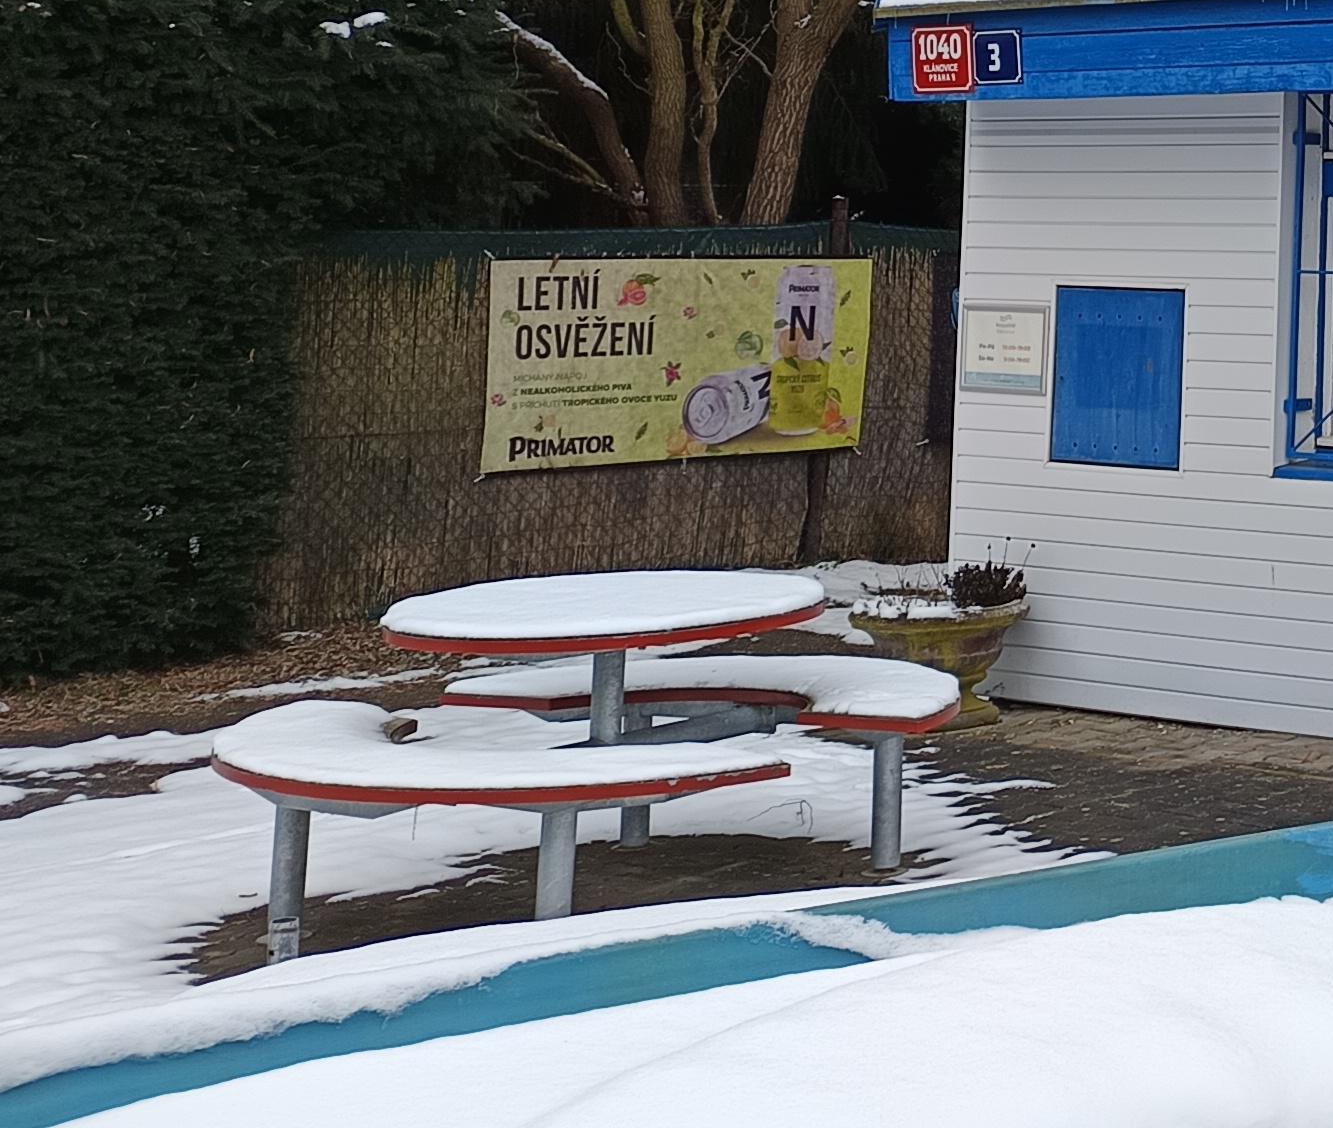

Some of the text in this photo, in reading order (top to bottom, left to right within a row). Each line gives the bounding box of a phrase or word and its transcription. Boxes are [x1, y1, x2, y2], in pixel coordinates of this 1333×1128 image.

[919, 32, 962, 61] 1040
[987, 43, 1001, 72] 3
[928, 73, 951, 82] PRAHA
[517, 269, 601, 311] LETNÍ
[515, 315, 656, 360] OSVĚŽENÍ
[789, 305, 816, 341] N
[611, 383, 633, 391] PIVA
[621, 394, 653, 404] OVOCE
[654, 393, 679, 402] YUZU
[508, 434, 615, 462] PRIMATOR
